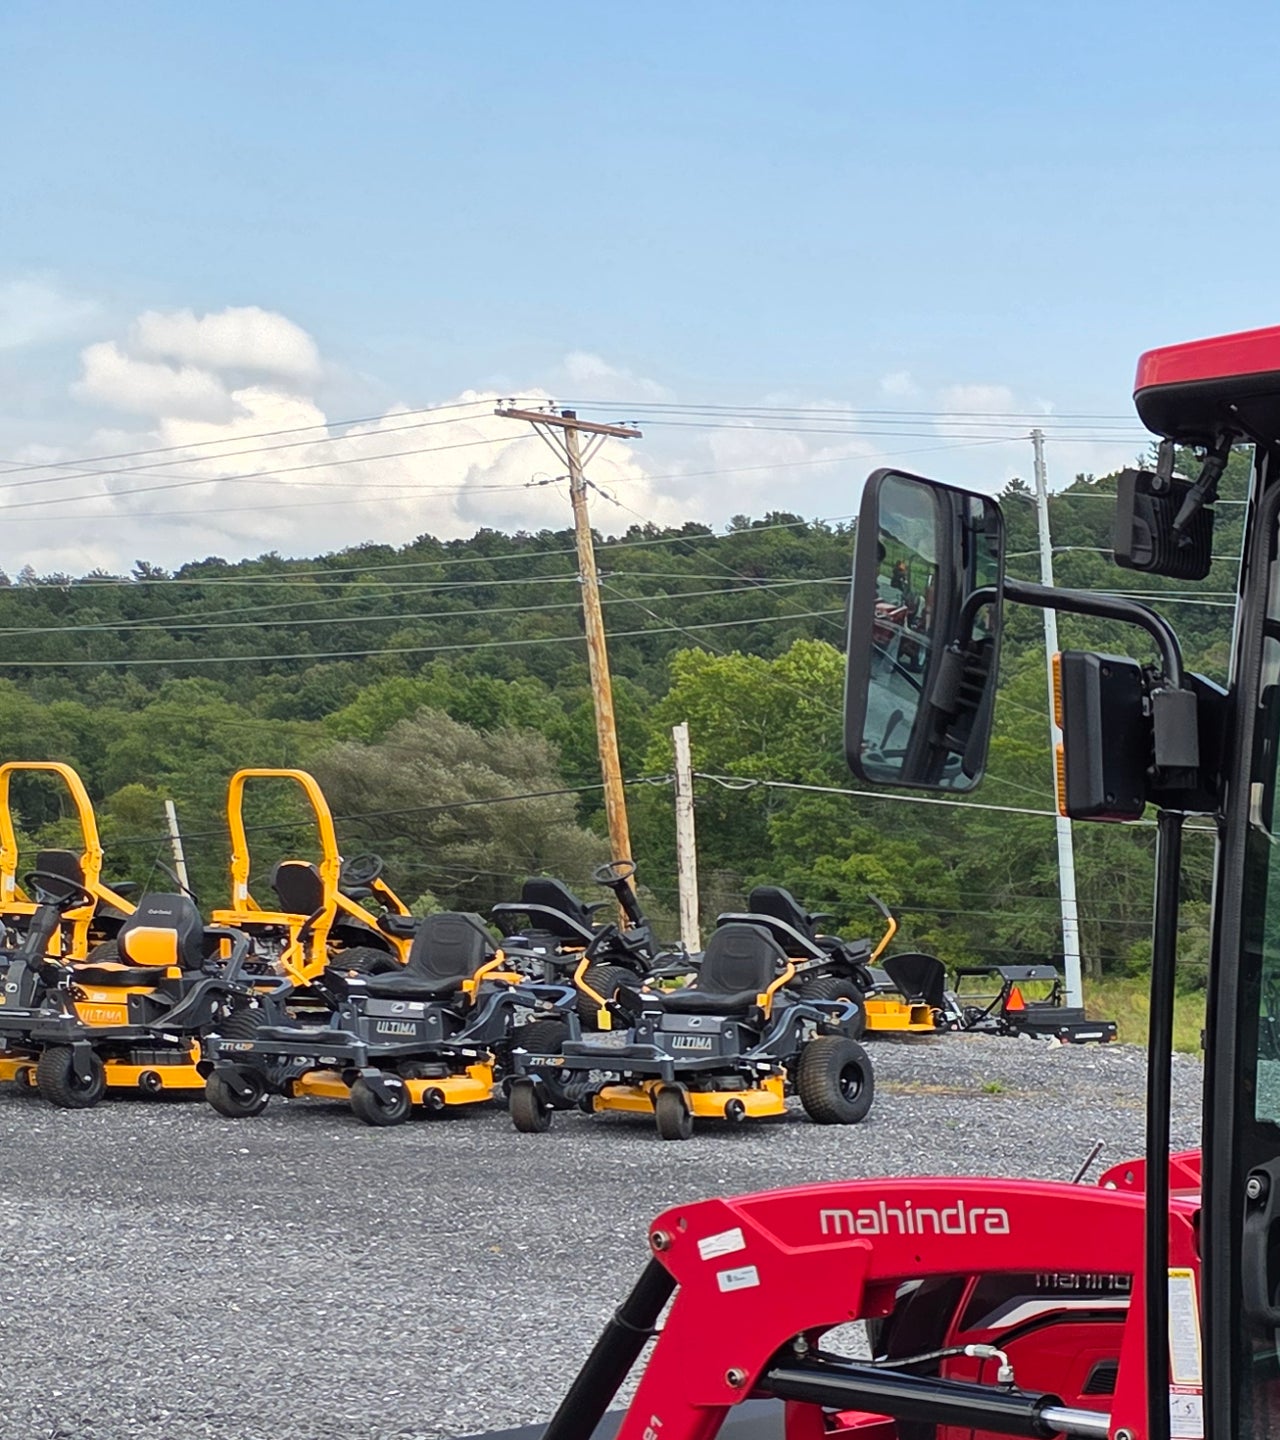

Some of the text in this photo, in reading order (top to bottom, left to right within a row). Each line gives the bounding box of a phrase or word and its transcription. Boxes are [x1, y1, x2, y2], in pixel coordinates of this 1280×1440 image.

[81, 1009, 123, 1023] ULTIMA
[376, 1020, 417, 1036] ULTIMA
[671, 1035, 713, 1050] ULTIMA
[820, 1198, 1010, 1236] mahindra
